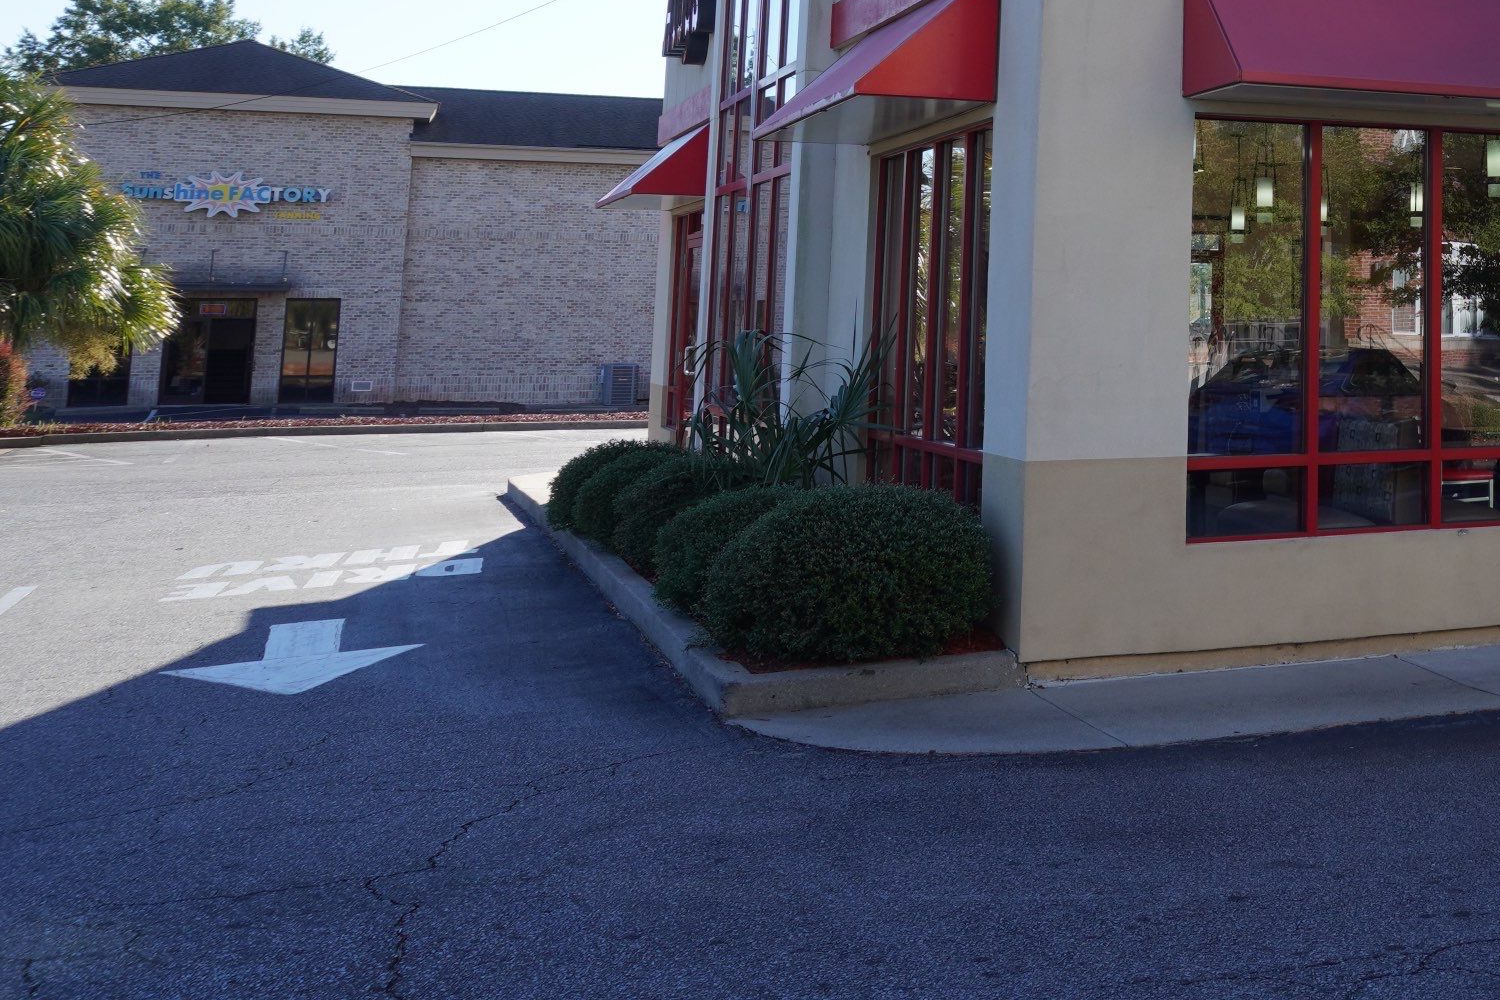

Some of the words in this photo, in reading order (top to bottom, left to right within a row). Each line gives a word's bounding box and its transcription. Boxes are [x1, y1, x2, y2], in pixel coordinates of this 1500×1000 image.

[139, 170, 161, 179] THE
[121, 182, 224, 200] Sunshine
[229, 185, 331, 203] FACTORY
[176, 540, 480, 580] THRU
[157, 557, 484, 602] DRIVE
